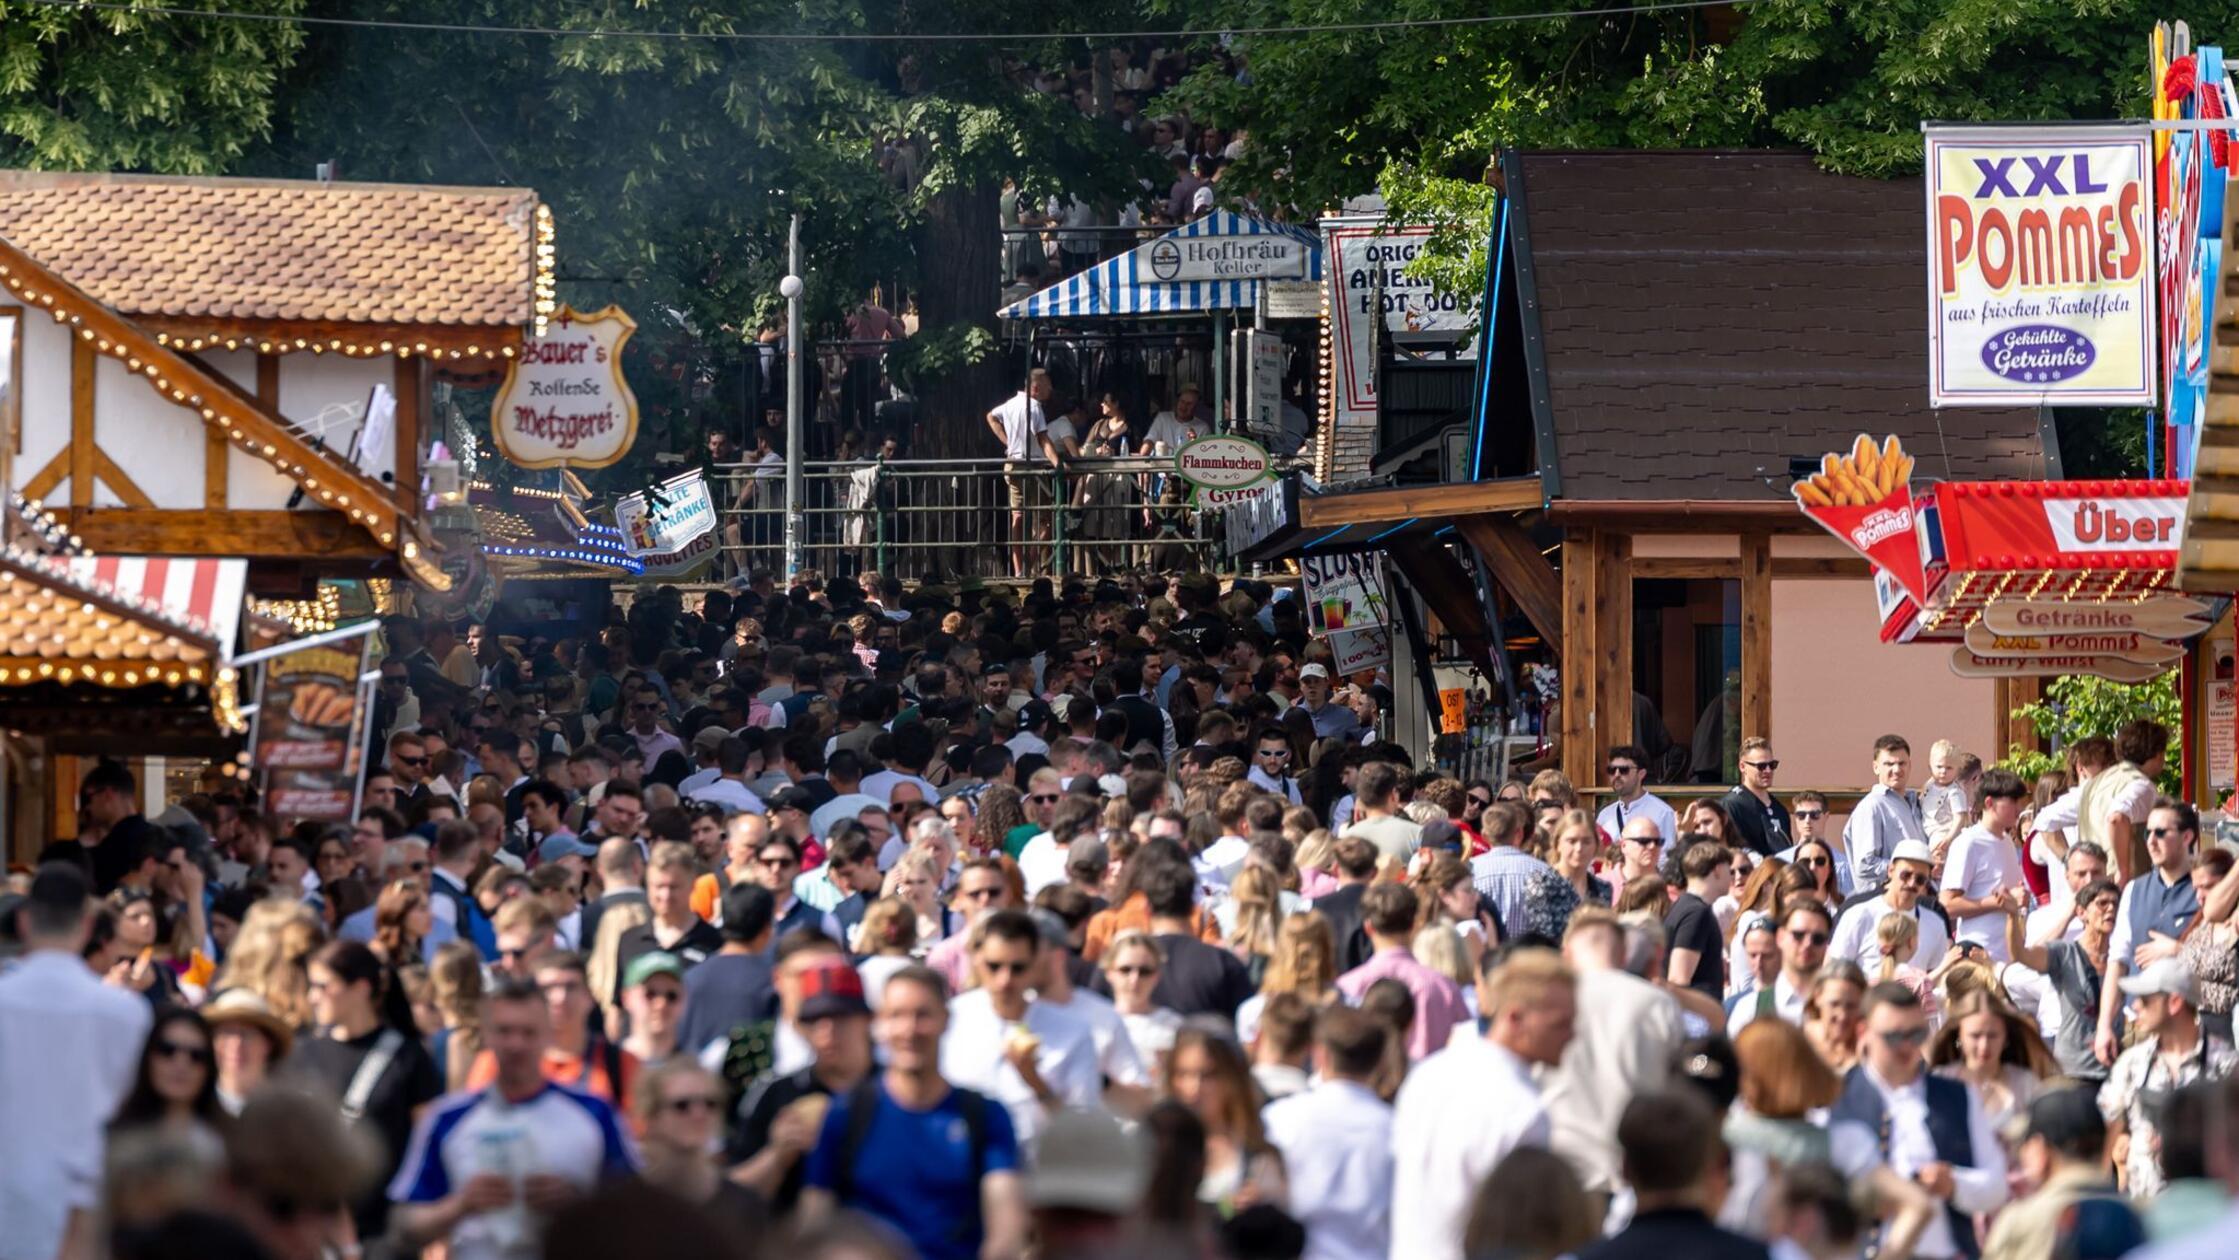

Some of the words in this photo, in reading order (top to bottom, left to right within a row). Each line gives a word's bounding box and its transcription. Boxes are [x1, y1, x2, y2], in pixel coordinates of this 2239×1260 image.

[1973, 154, 2109, 198] XXL
[1188, 241, 1287, 262] Hofbräu
[1214, 261, 1262, 274] Keller
[1424, 292, 1472, 312] DO
[1949, 309, 1976, 322] aus
[1981, 298, 2040, 325] frischen
[2046, 293, 2130, 319] Kartoffeln
[2004, 328, 2068, 350] Gekühlte
[1994, 345, 2087, 376] Getränke
[529, 378, 601, 396] Rollende
[514, 402, 614, 449] Metzgerei
[1183, 454, 1262, 470] Flammkuchen
[2075, 501, 2176, 543] Über
[2016, 608, 2133, 627] Getränke
[1992, 636, 2041, 650] XXL
